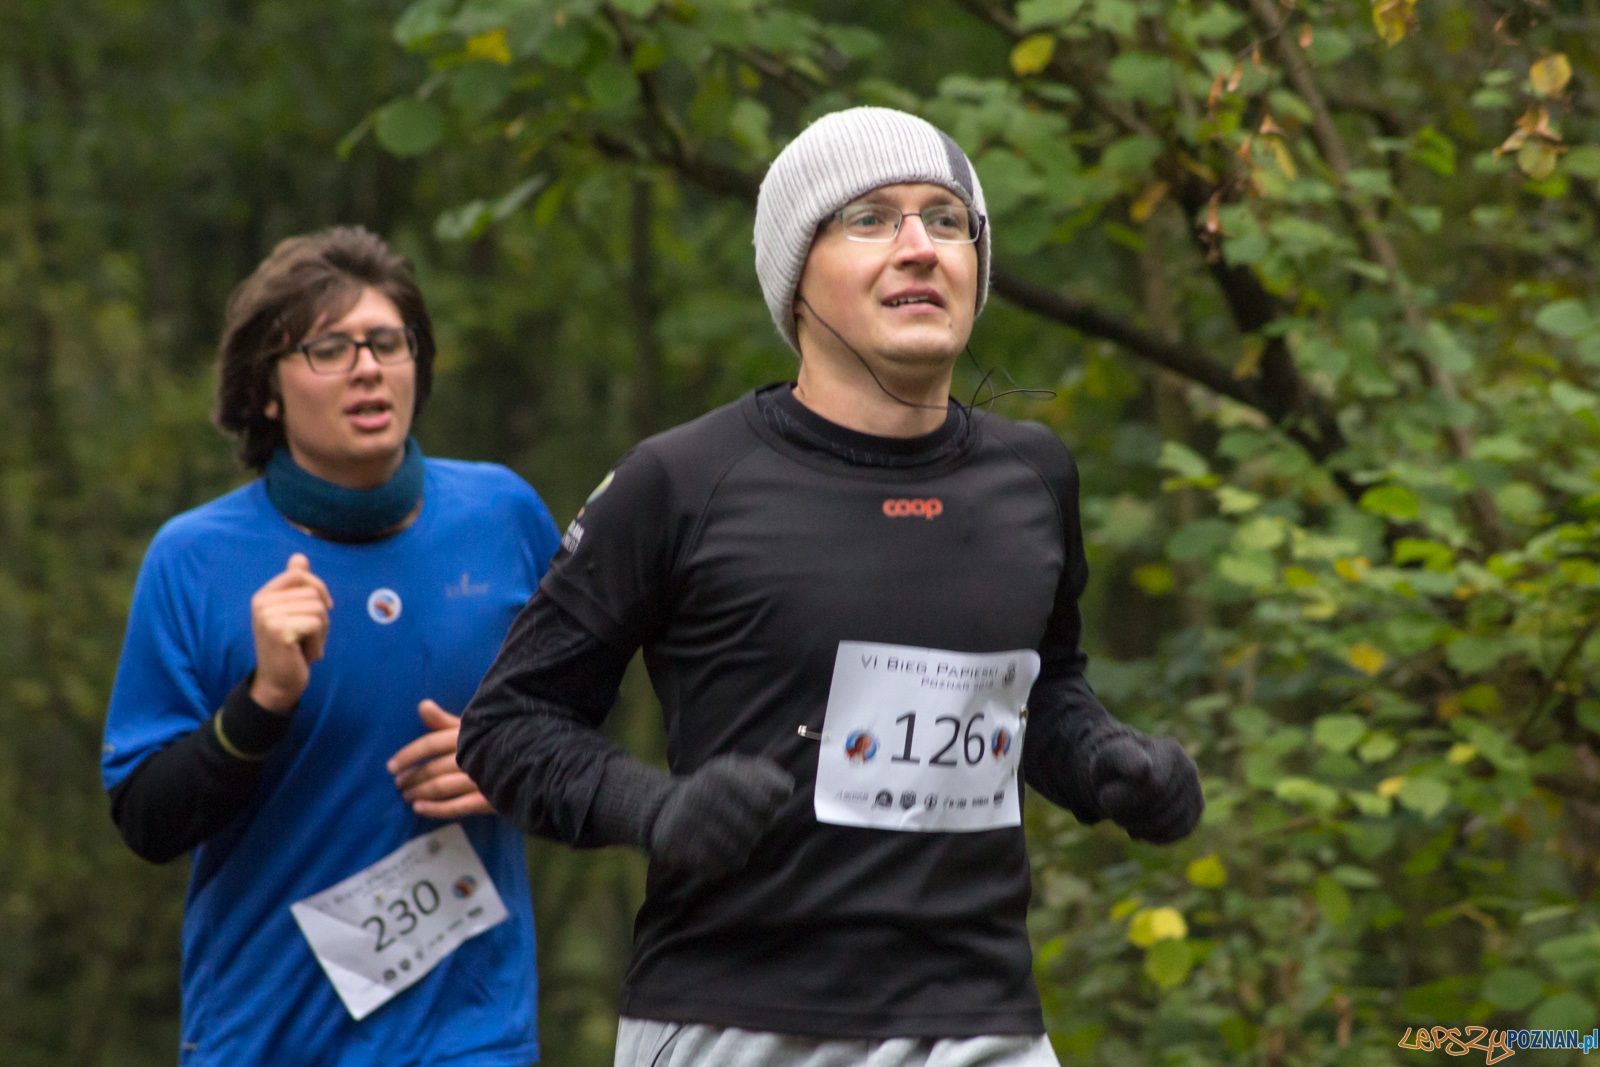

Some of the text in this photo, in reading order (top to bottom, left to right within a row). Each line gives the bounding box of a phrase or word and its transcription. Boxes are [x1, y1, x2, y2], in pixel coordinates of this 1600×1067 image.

[882, 498, 943, 520] coop
[861, 653, 878, 670] VI
[891, 710, 985, 767] 126
[361, 880, 441, 953] 230
